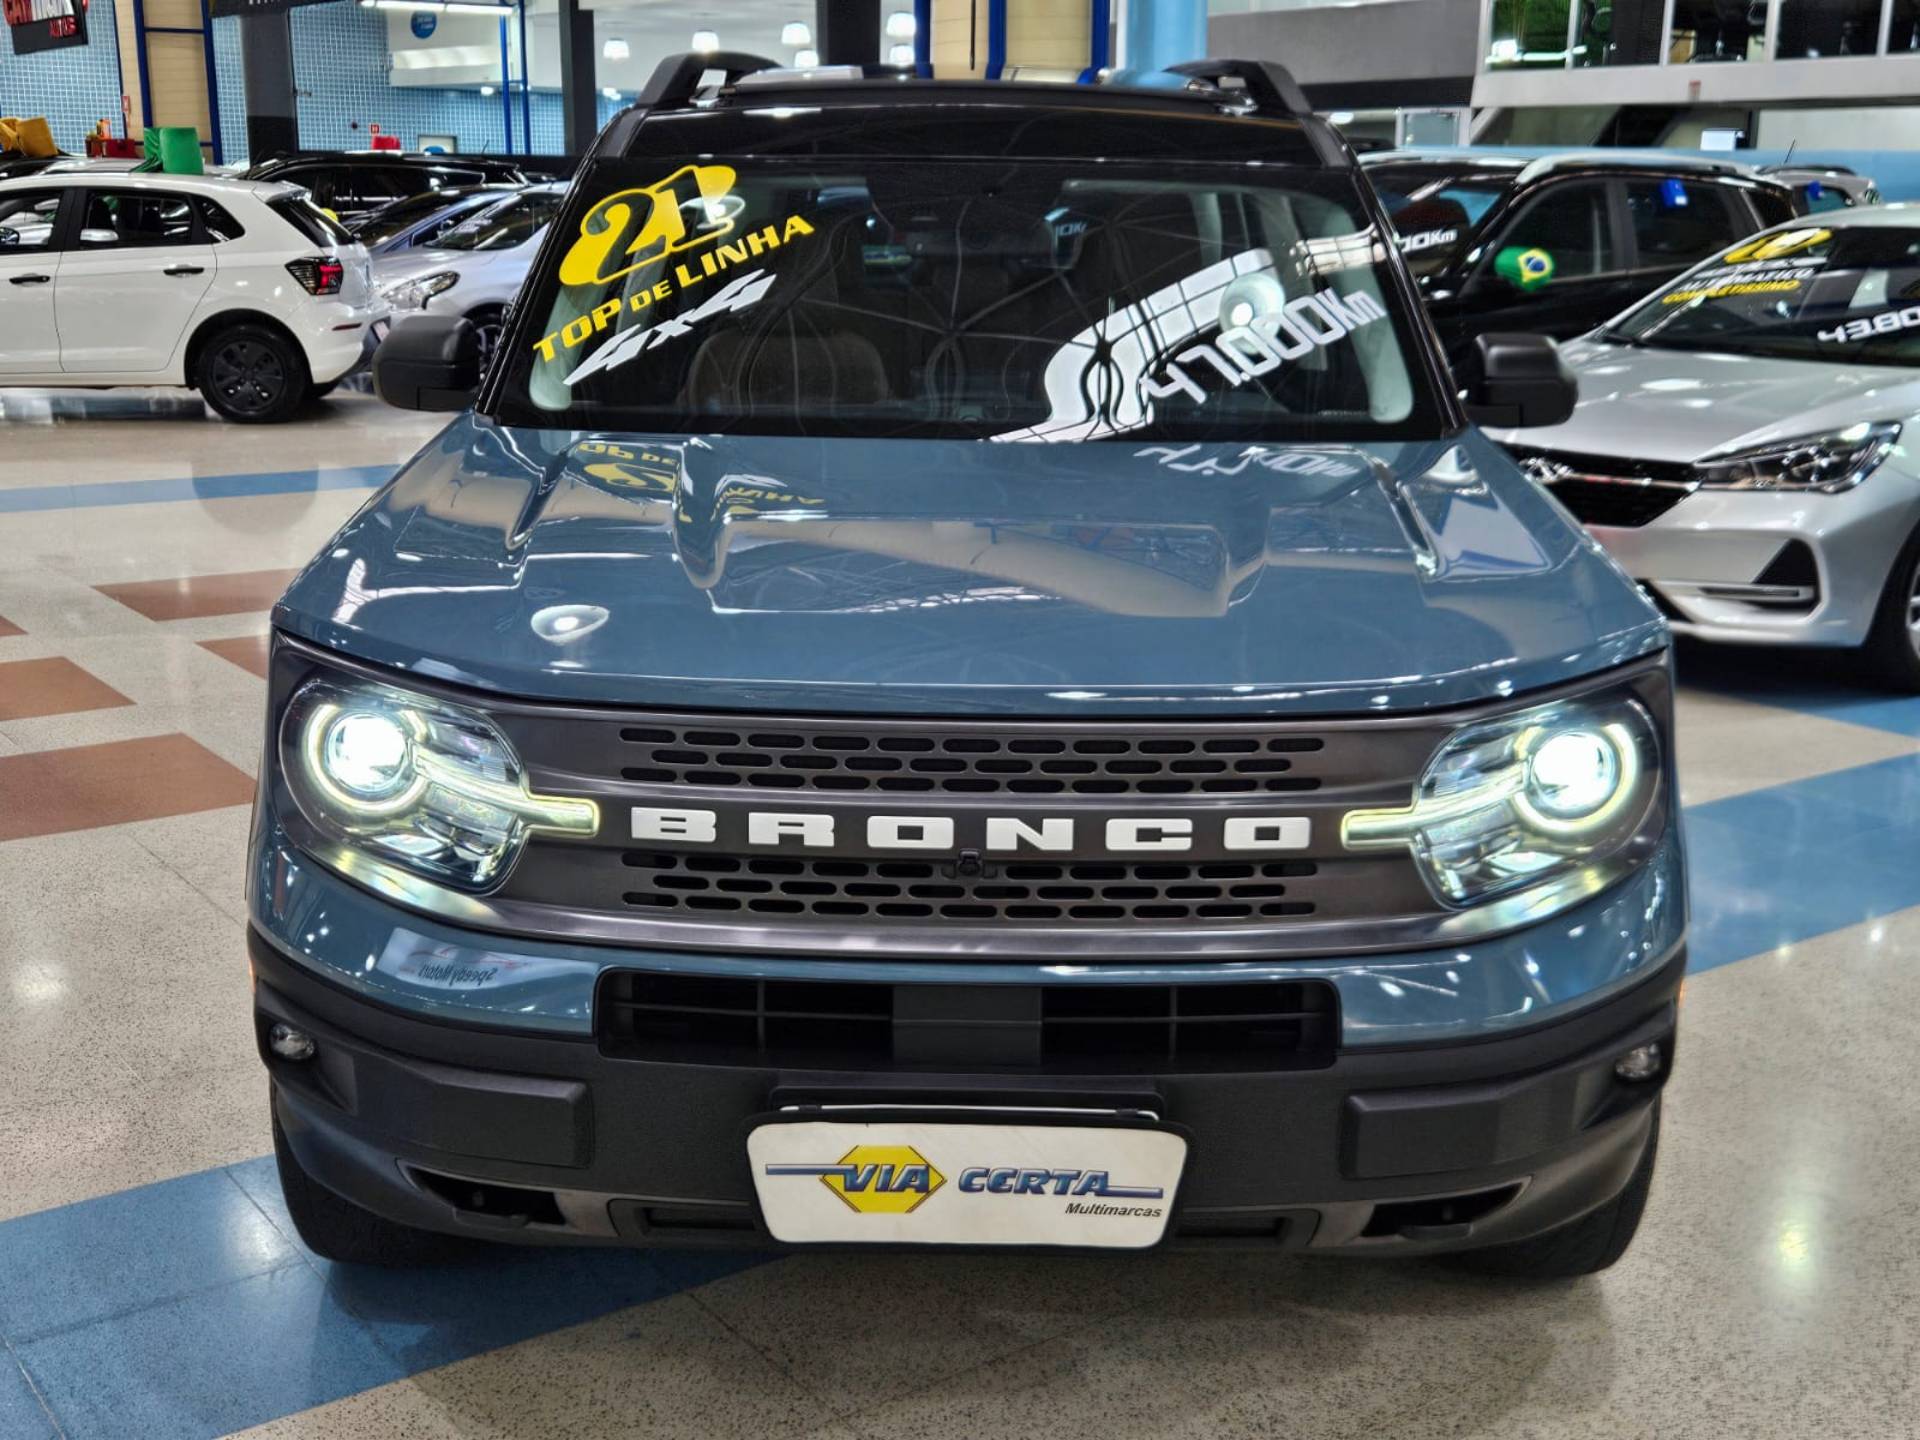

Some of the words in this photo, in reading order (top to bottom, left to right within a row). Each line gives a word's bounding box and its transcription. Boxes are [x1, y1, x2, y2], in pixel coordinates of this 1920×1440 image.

[559, 165, 736, 286] 21
[533, 298, 621, 362] TOP
[630, 279, 673, 312] DE
[675, 214, 815, 288] LINHA
[631, 806, 1311, 852] BRONCO
[841, 1163, 931, 1194] VIA
[957, 1166, 1110, 1197] CERTA
[1065, 1202, 1163, 1219] Multimarcas
